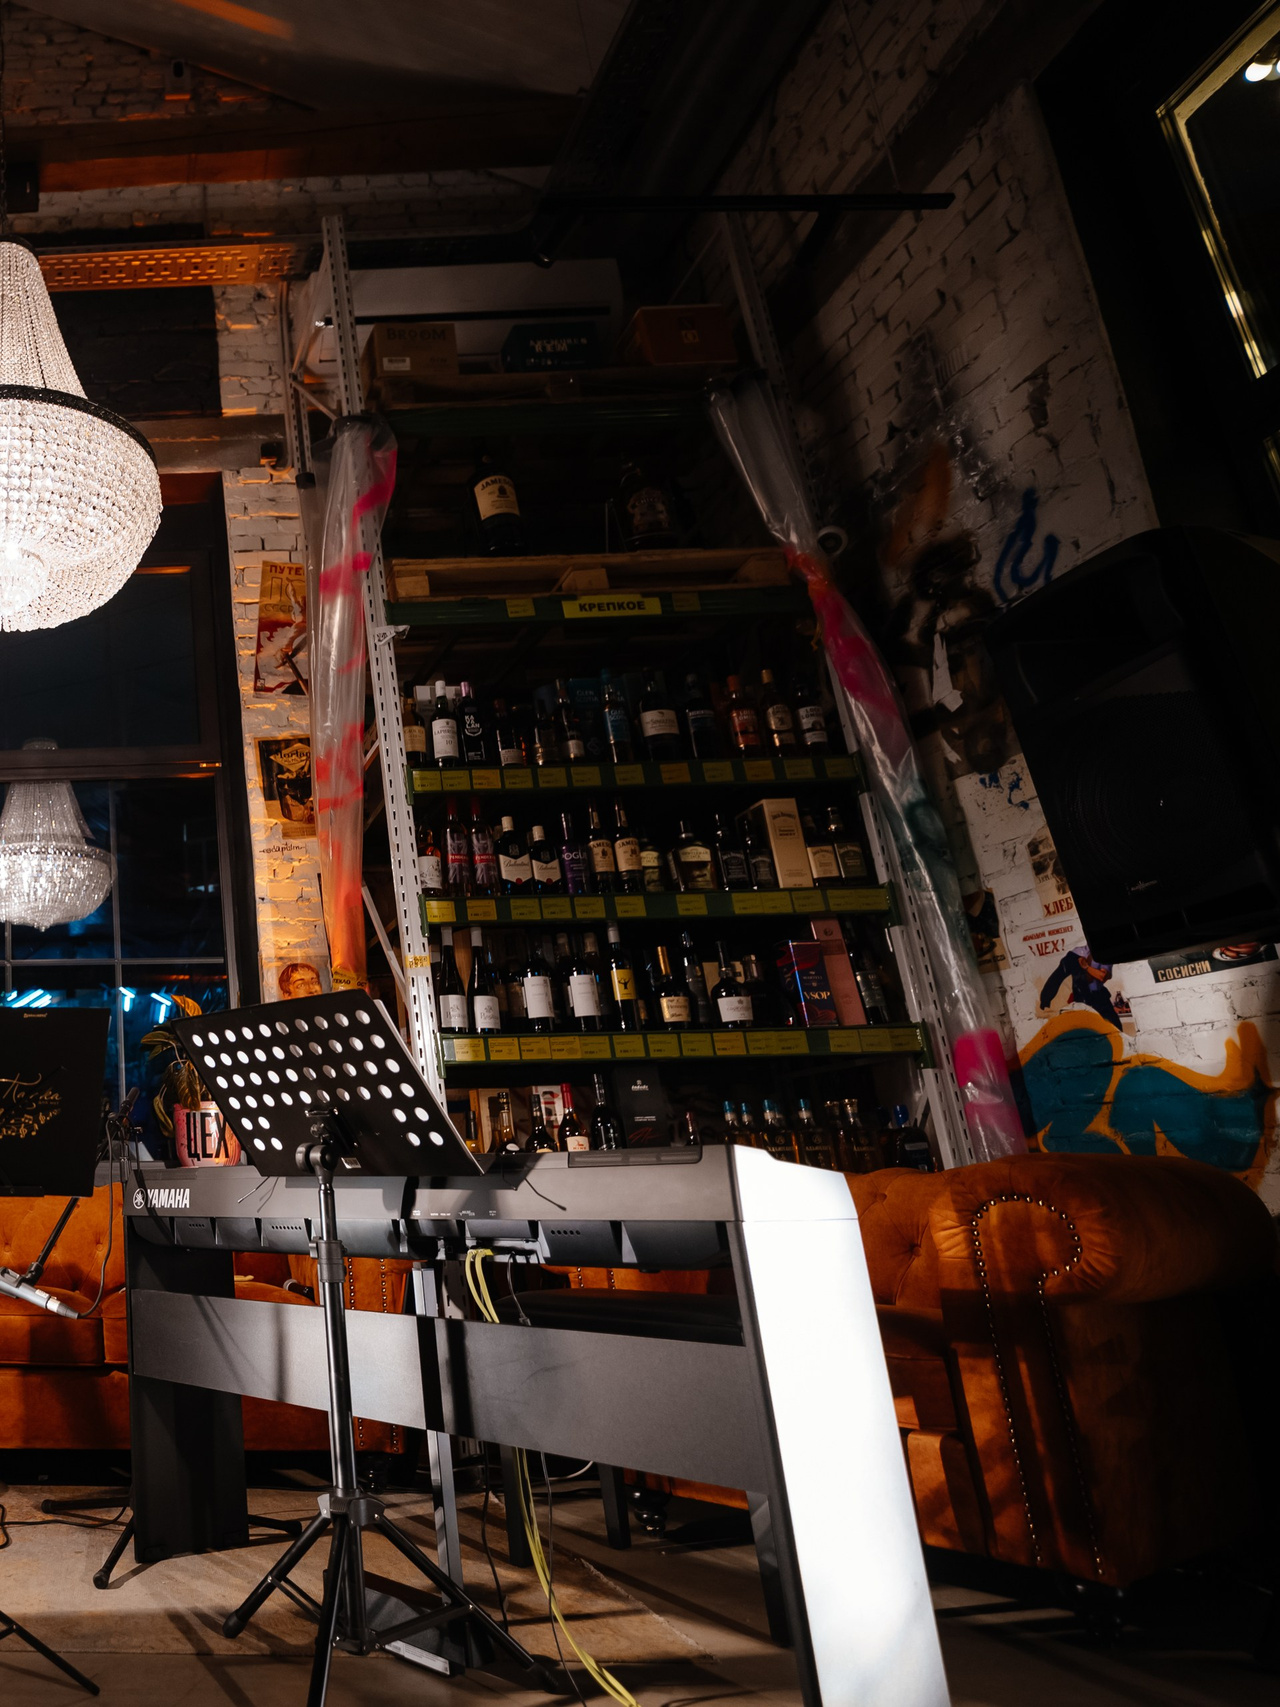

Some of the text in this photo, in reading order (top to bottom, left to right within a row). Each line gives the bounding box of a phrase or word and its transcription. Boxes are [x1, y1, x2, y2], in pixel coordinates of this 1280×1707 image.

[386, 328, 446, 341] BROOM
[269, 564, 305, 576] ПУТЕ
[578, 601, 646, 612] КРЕПКОЕ
[1043, 896, 1074, 918] ХЛЕБ
[803, 991, 831, 1000] VSOP
[185, 1112, 230, 1162] ЦЕХ
[147, 1188, 190, 1209] YAMAHA
